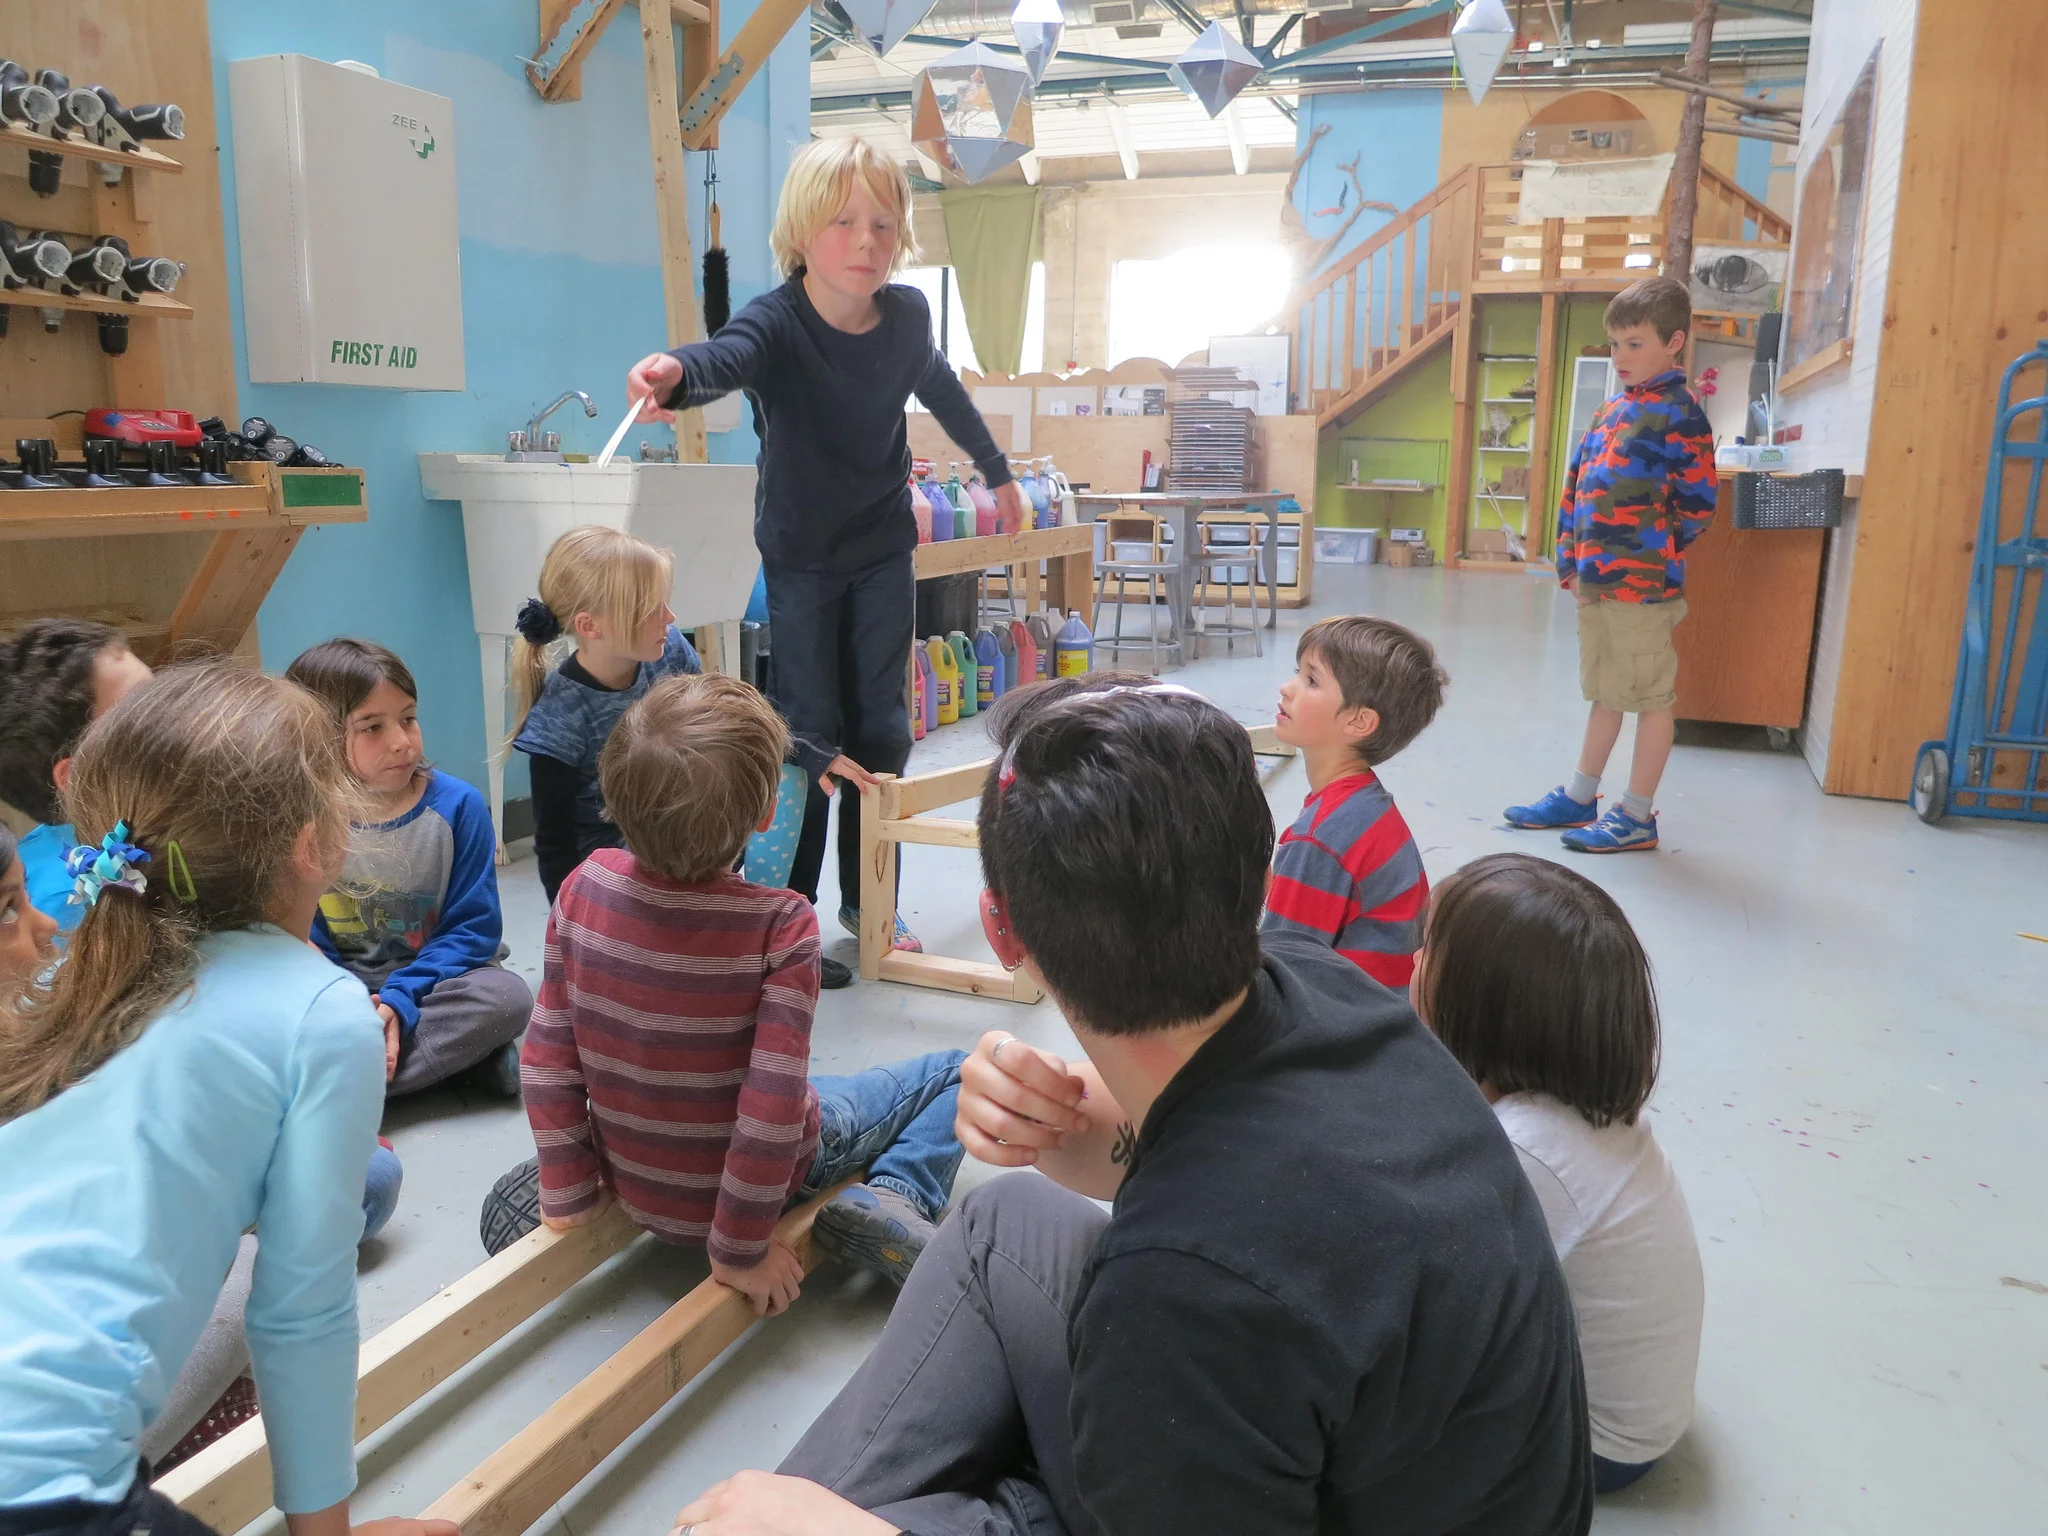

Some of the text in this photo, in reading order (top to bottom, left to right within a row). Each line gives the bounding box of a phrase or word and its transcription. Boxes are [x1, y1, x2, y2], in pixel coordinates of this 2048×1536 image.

[392, 113, 417, 130] ZEE
[331, 340, 417, 368] FIRST AID
